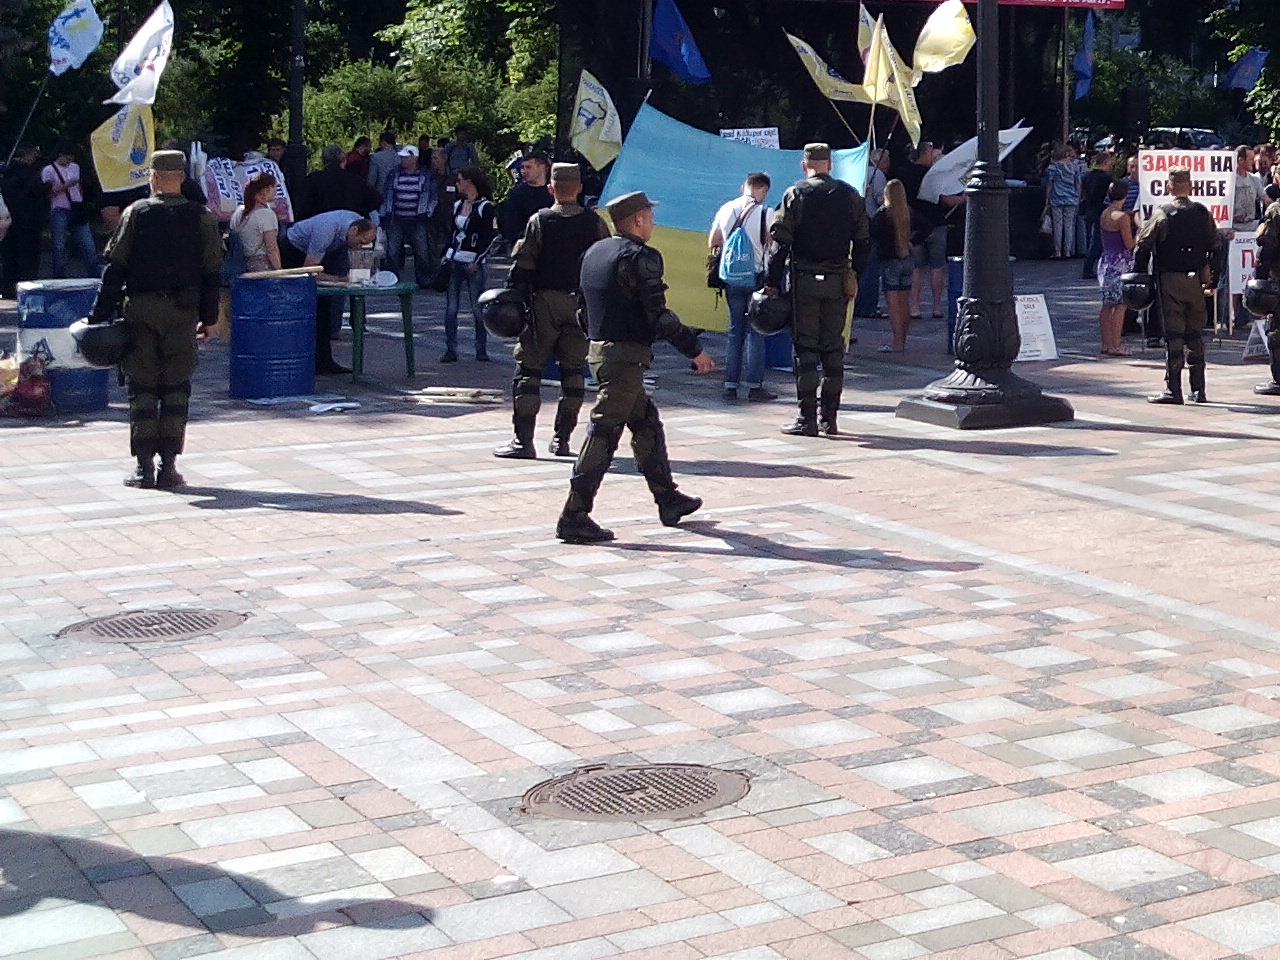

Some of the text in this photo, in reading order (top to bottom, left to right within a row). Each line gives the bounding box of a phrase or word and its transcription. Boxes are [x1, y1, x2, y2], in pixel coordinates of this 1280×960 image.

[1142, 155, 1232, 172] ЗАКОН НА
[1150, 180, 1226, 196] СЖБЕ
